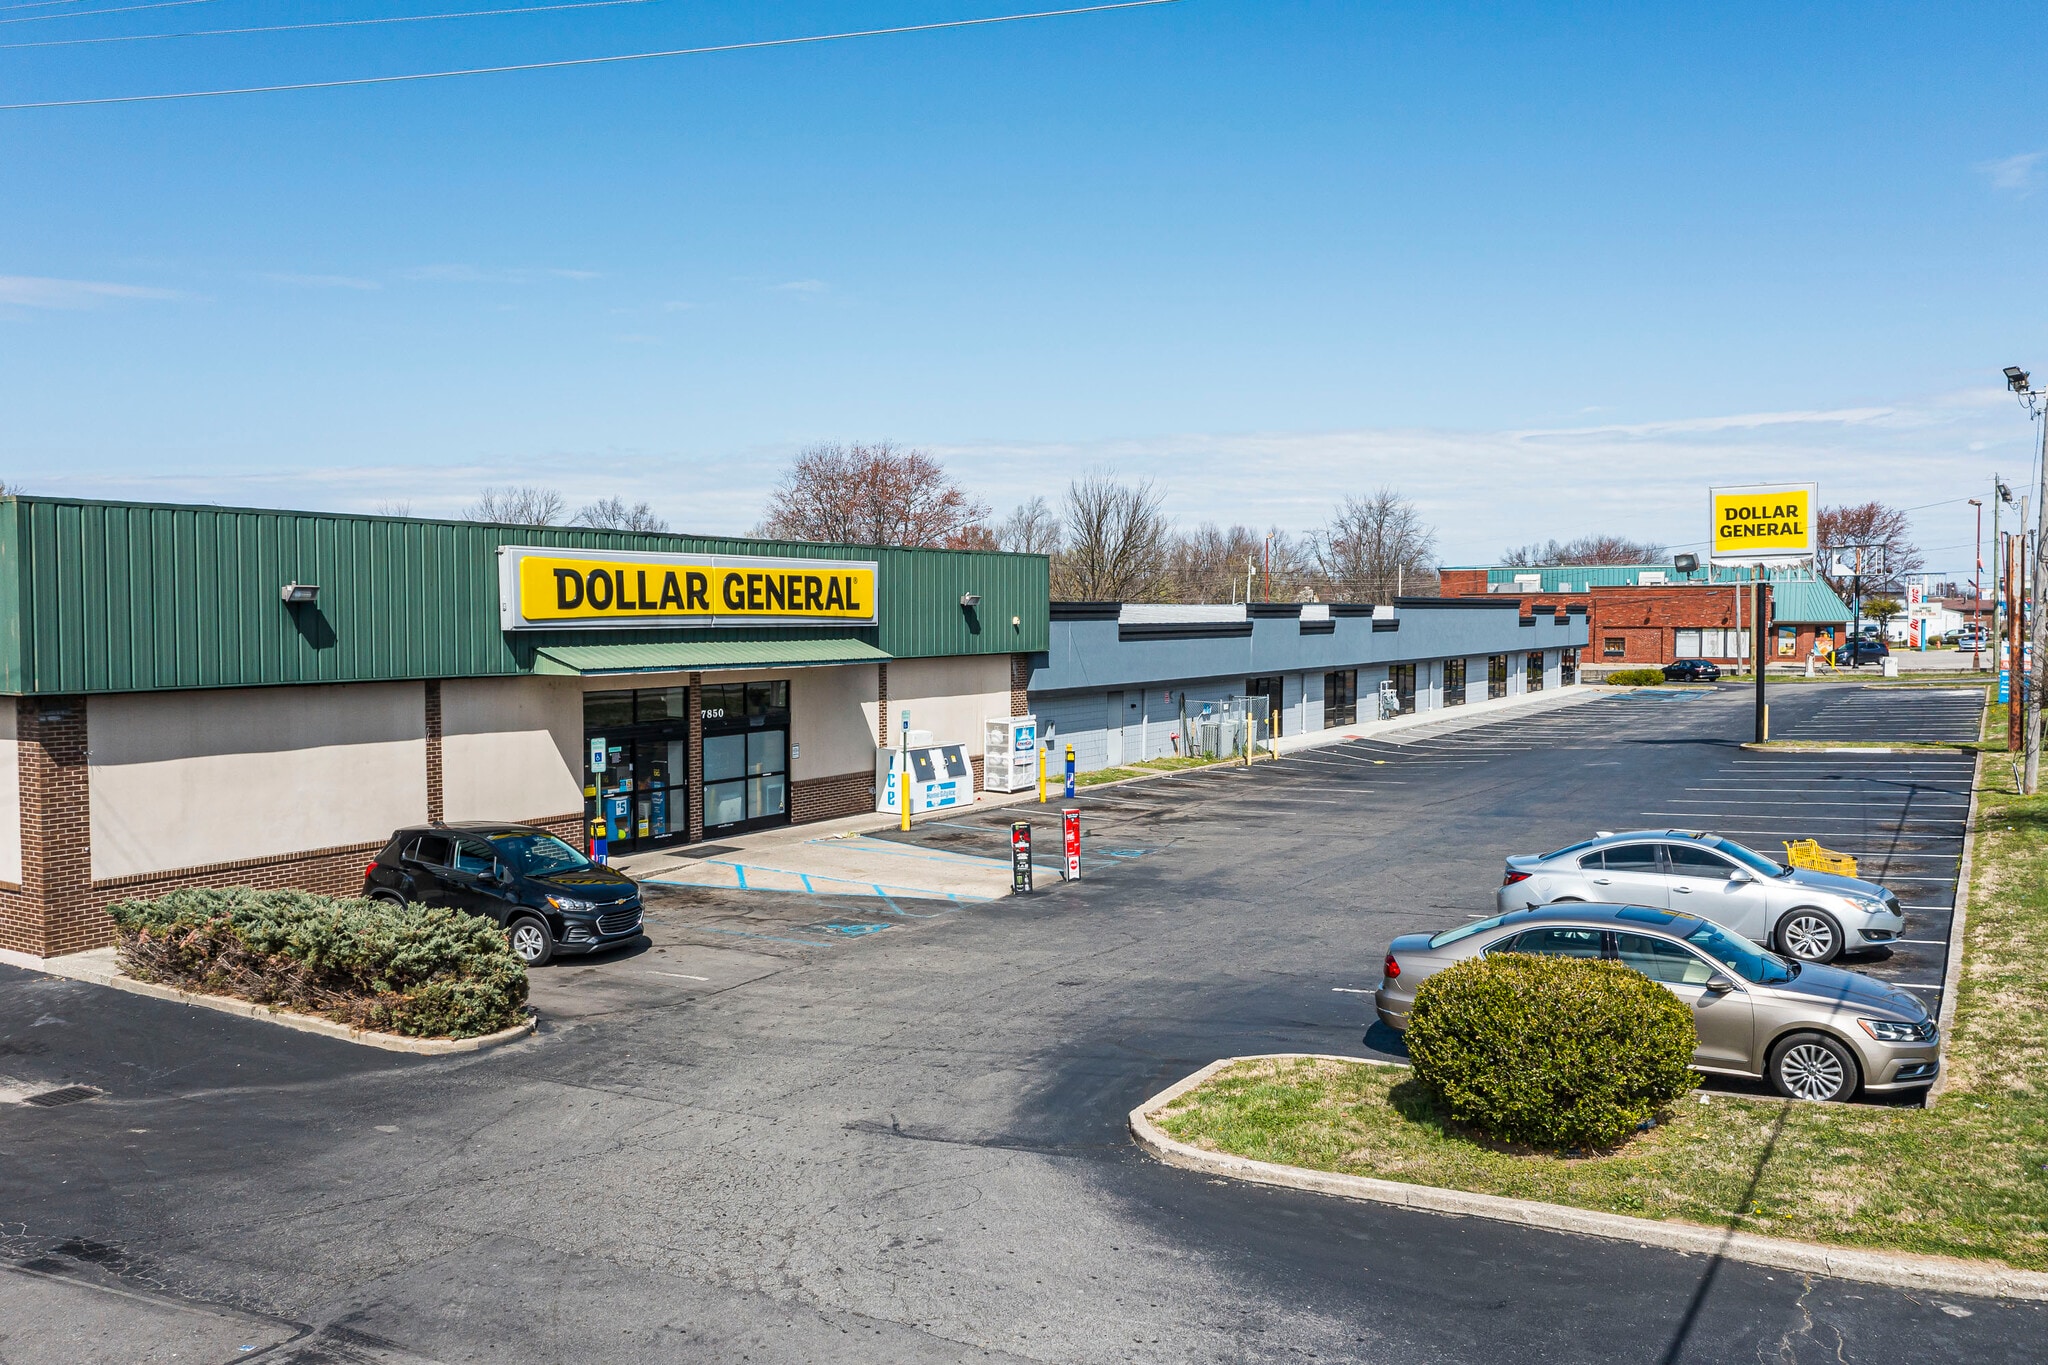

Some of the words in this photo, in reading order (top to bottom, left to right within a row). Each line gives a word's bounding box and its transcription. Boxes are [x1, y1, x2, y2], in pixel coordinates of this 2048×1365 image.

[1724, 504, 1799, 521] DOLLAR
[1720, 521, 1804, 538] GENERAL
[553, 567, 710, 611] DOLLAR
[722, 572, 861, 611] GENERAL
[701, 708, 724, 719] 7850
[616, 801, 626, 814] $5
